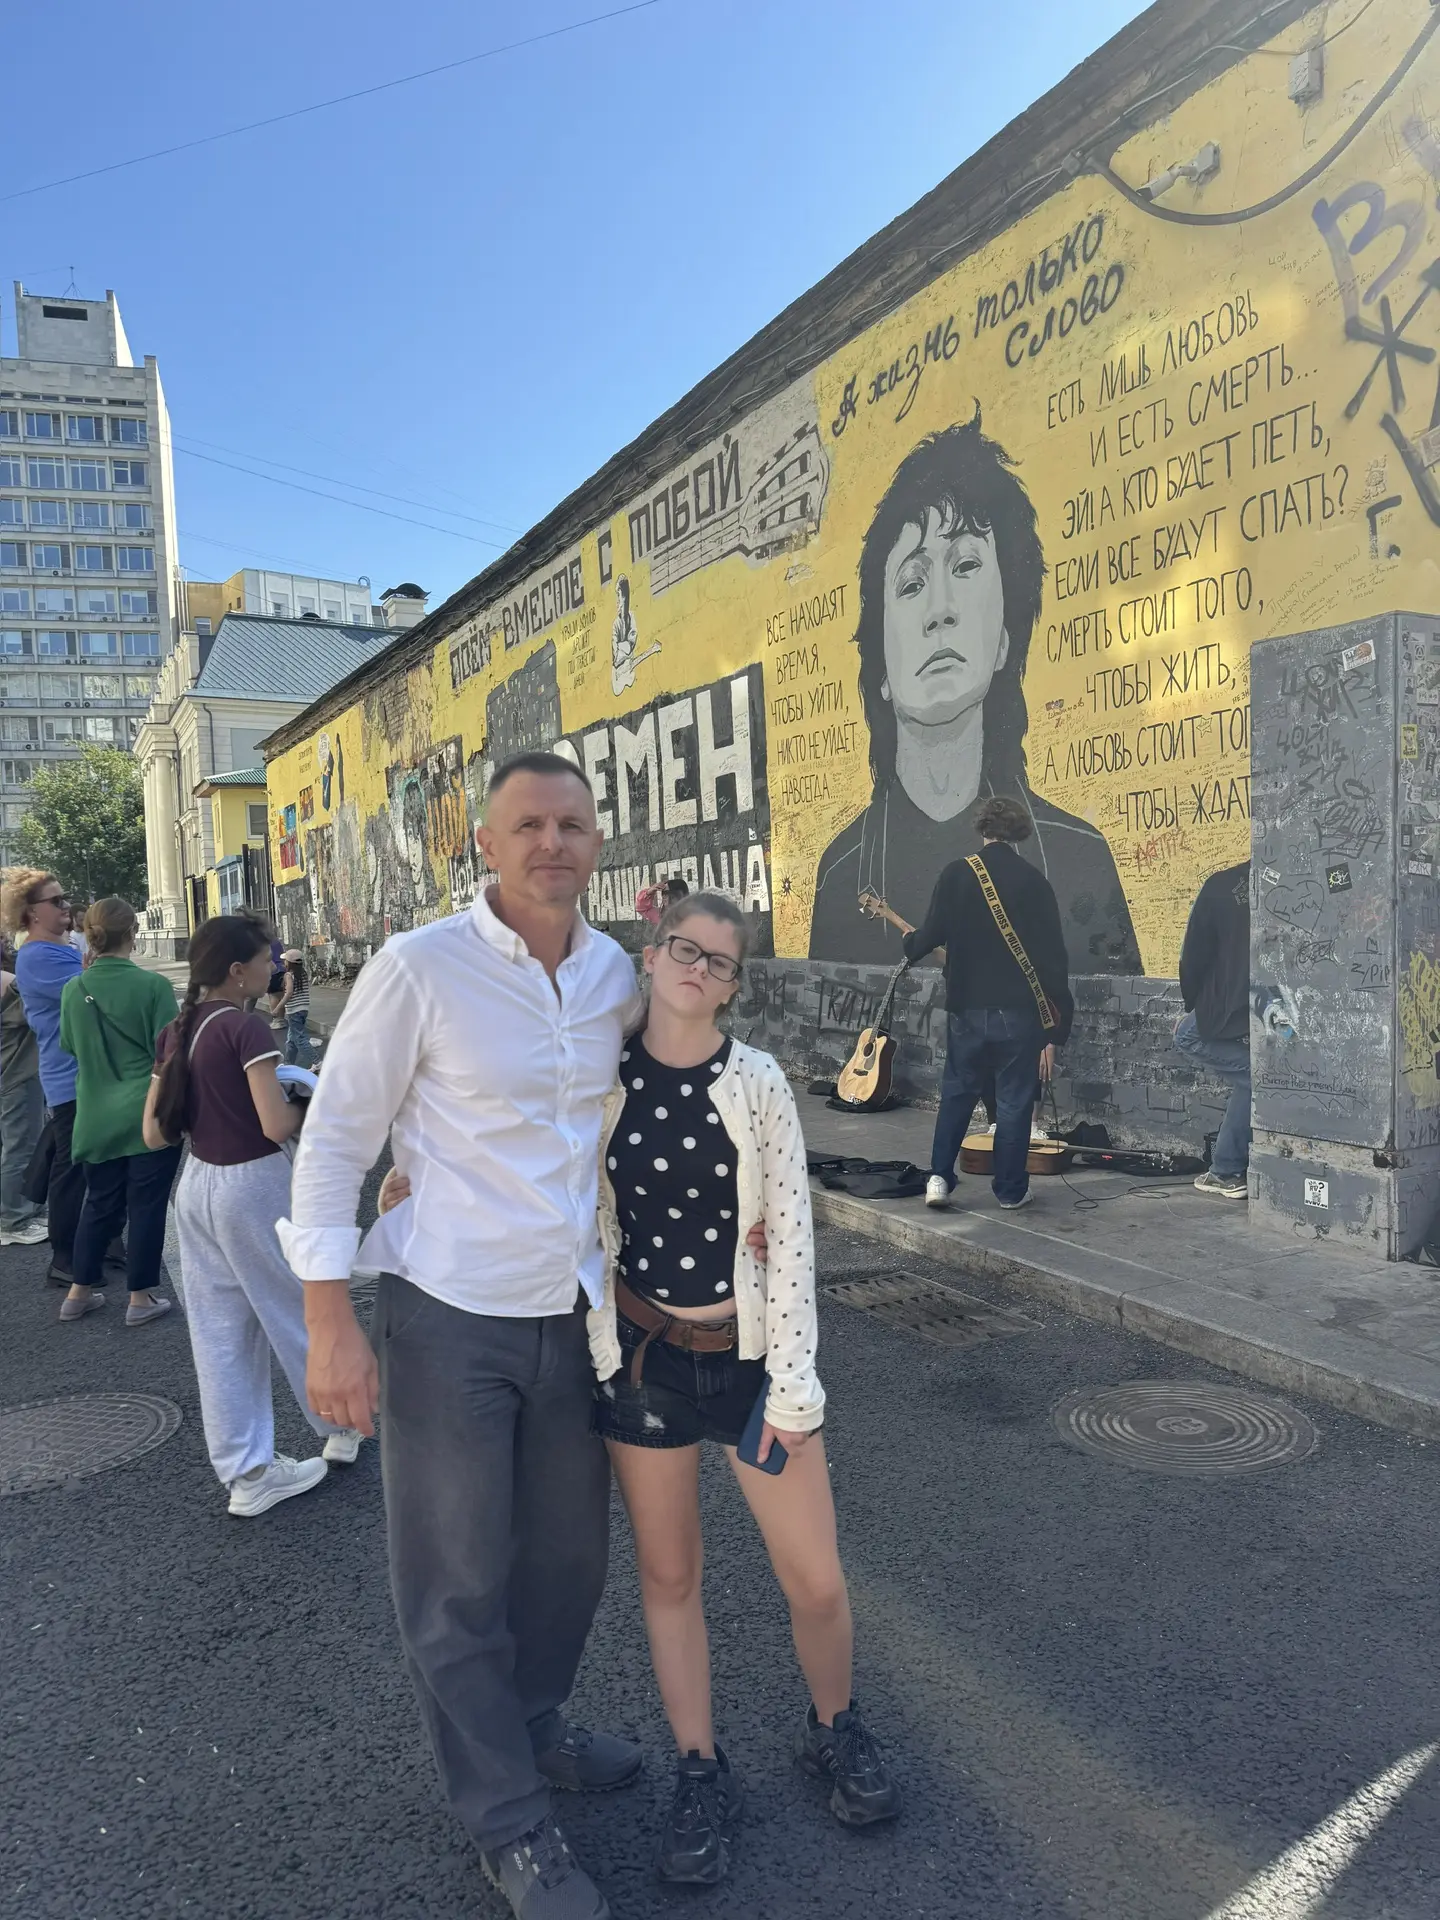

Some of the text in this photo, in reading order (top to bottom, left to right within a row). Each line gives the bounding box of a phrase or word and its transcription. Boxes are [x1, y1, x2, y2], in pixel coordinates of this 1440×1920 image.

[1047, 290, 1259, 429] ЕСТЬ ЛИШЬ ЛЮБОВЬ
[1090, 427, 1107, 467] И
[1118, 398, 1174, 457] ЕСТЬ
[1100, 476, 1115, 527] А
[1123, 466, 1158, 518] КТО
[1166, 432, 1242, 499] БУДЕТ
[1252, 401, 1332, 470] ПЕТЬ,
[502, 555, 585, 652] ВМЕСТЕ
[598, 530, 613, 585] С
[629, 433, 743, 560] ТОБОЙ
[1055, 550, 1100, 601] ЕСЛИ
[1108, 535, 1142, 585] ВСЕ
[1153, 507, 1227, 570] БУДУТ
[1240, 464, 1349, 542] СПАТЬ?
[766, 584, 848, 647] ВСЕ НАХОДЯТ
[1047, 609, 1112, 664] СМЕРТЬ
[1118, 587, 1181, 645] СТОИТ
[1187, 567, 1264, 624] ТОГО,
[776, 644, 827, 685] ВРЕМЯ,
[1086, 659, 1152, 714] ЧТОБЫ
[1161, 642, 1237, 699] ЖИТЬ,
[770, 690, 805, 728] ЧТОБЫ
[1043, 745, 1059, 784] А
[1065, 731, 1132, 780] ЛЮБОВЬ
[1137, 714, 1203, 767] СТОИТ
[1211, 705, 1251, 753] ТОГ
[777, 734, 807, 766] НИКТО
[809, 733, 821, 760] НЕ
[1117, 785, 1179, 833] ЧТОБЫ
[1191, 775, 1251, 825] ЖДАТ
[979, 873, 989, 885] DO
[984, 885, 998, 902] NOT
[991, 903, 1010, 931] CROSS
[1005, 931, 1025, 958] POLICE
[1038, 1000, 1053, 1025] CROSS
[513, 1851, 524, 1872] ecco
